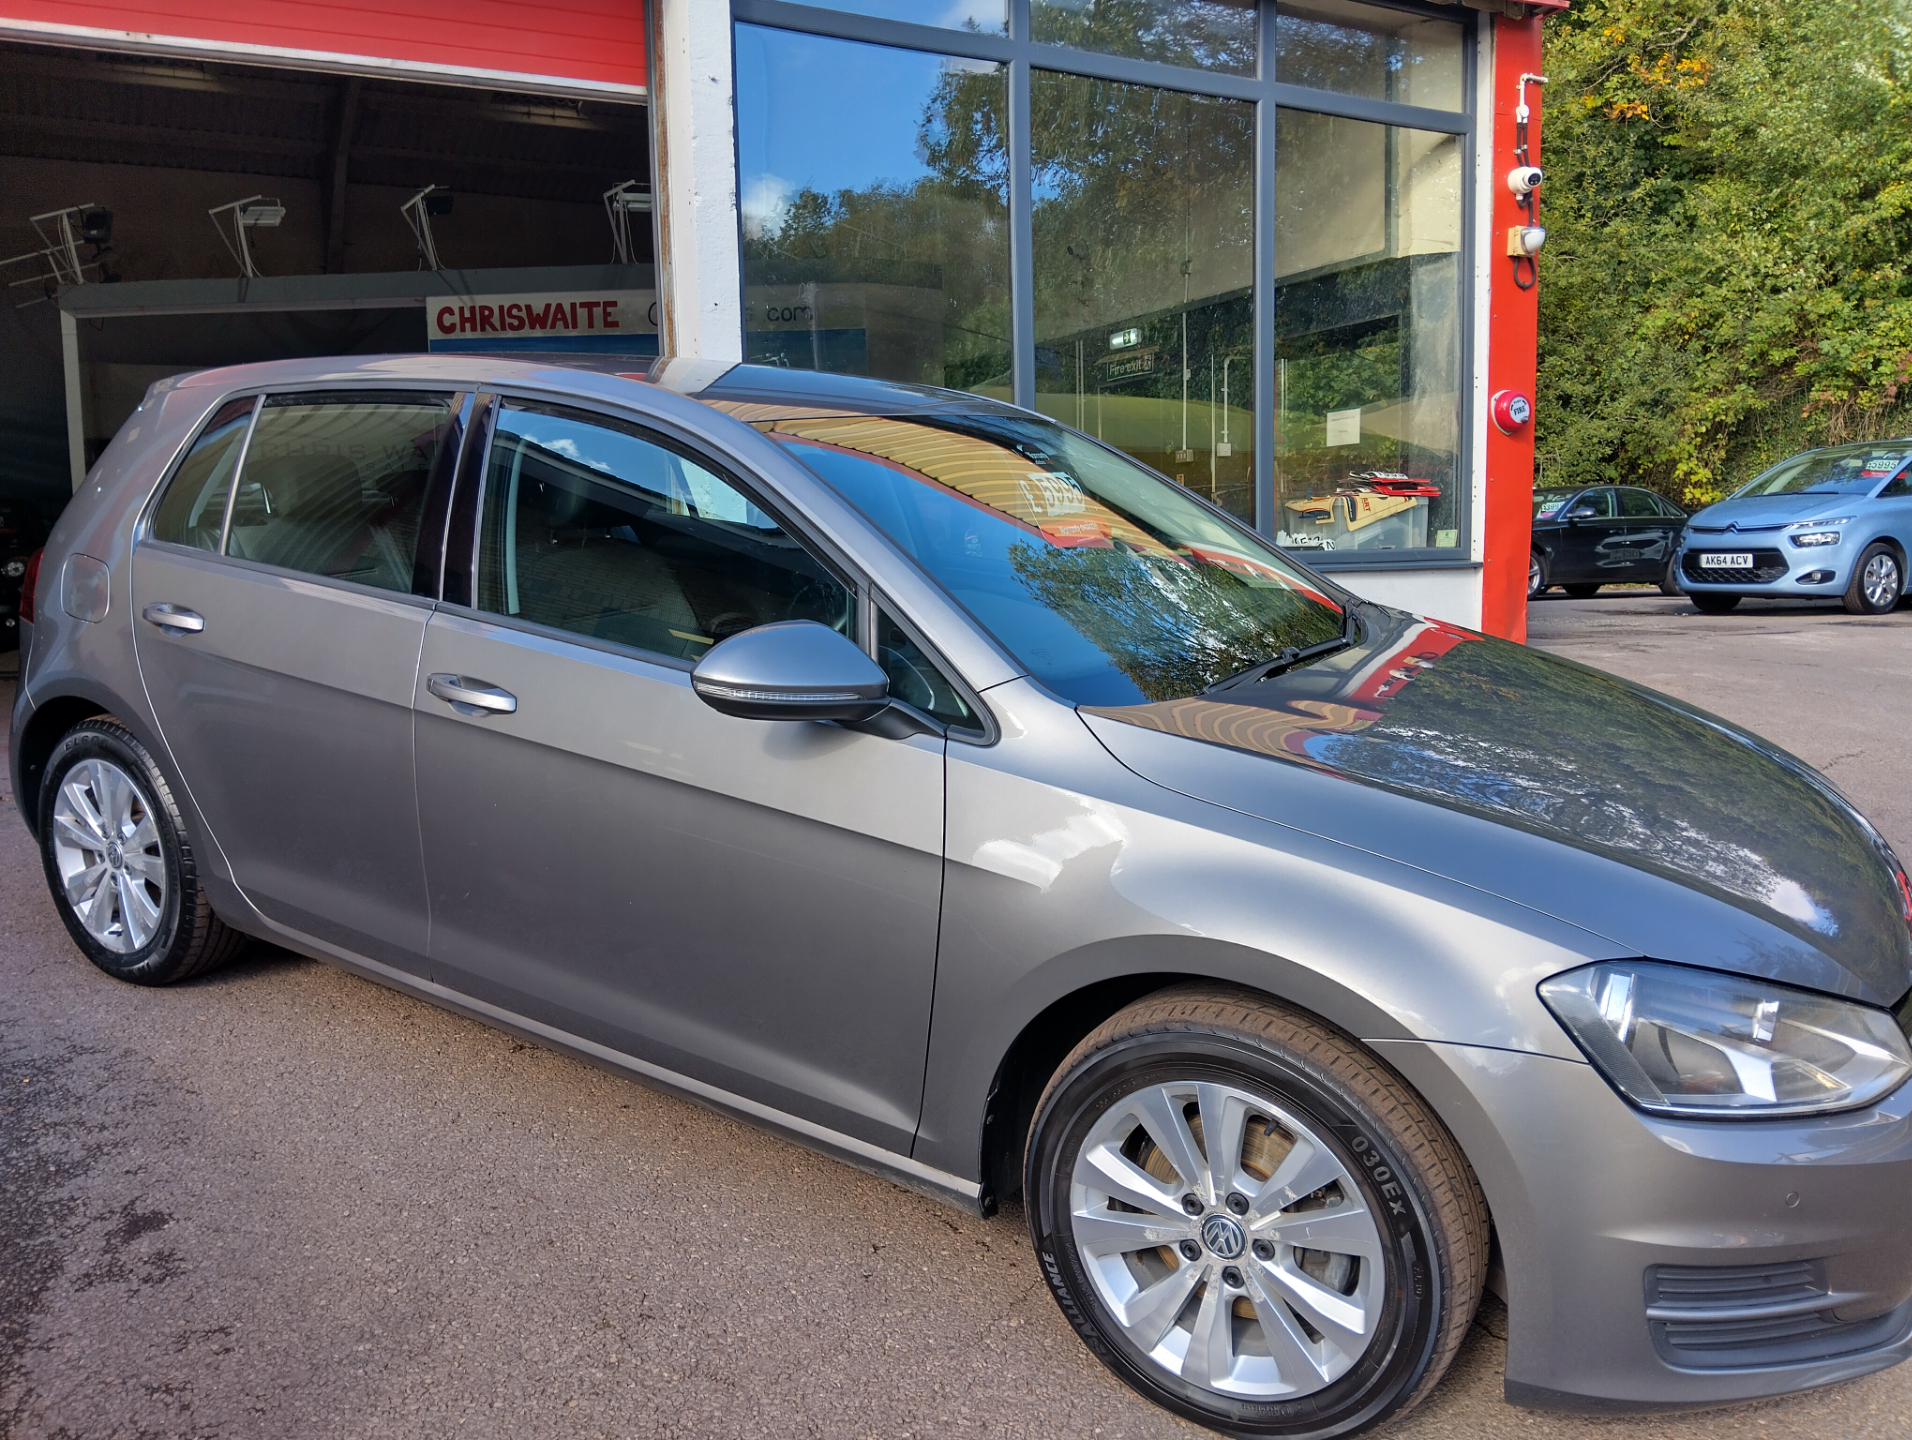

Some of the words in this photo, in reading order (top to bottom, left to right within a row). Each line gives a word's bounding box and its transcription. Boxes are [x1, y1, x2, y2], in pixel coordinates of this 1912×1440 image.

[436, 300, 620, 335] CHRISWAITE
[1705, 555, 1728, 566] AK64
[1730, 555, 1749, 565] ACV
[1041, 1250, 1099, 1338] ALLIANCE
